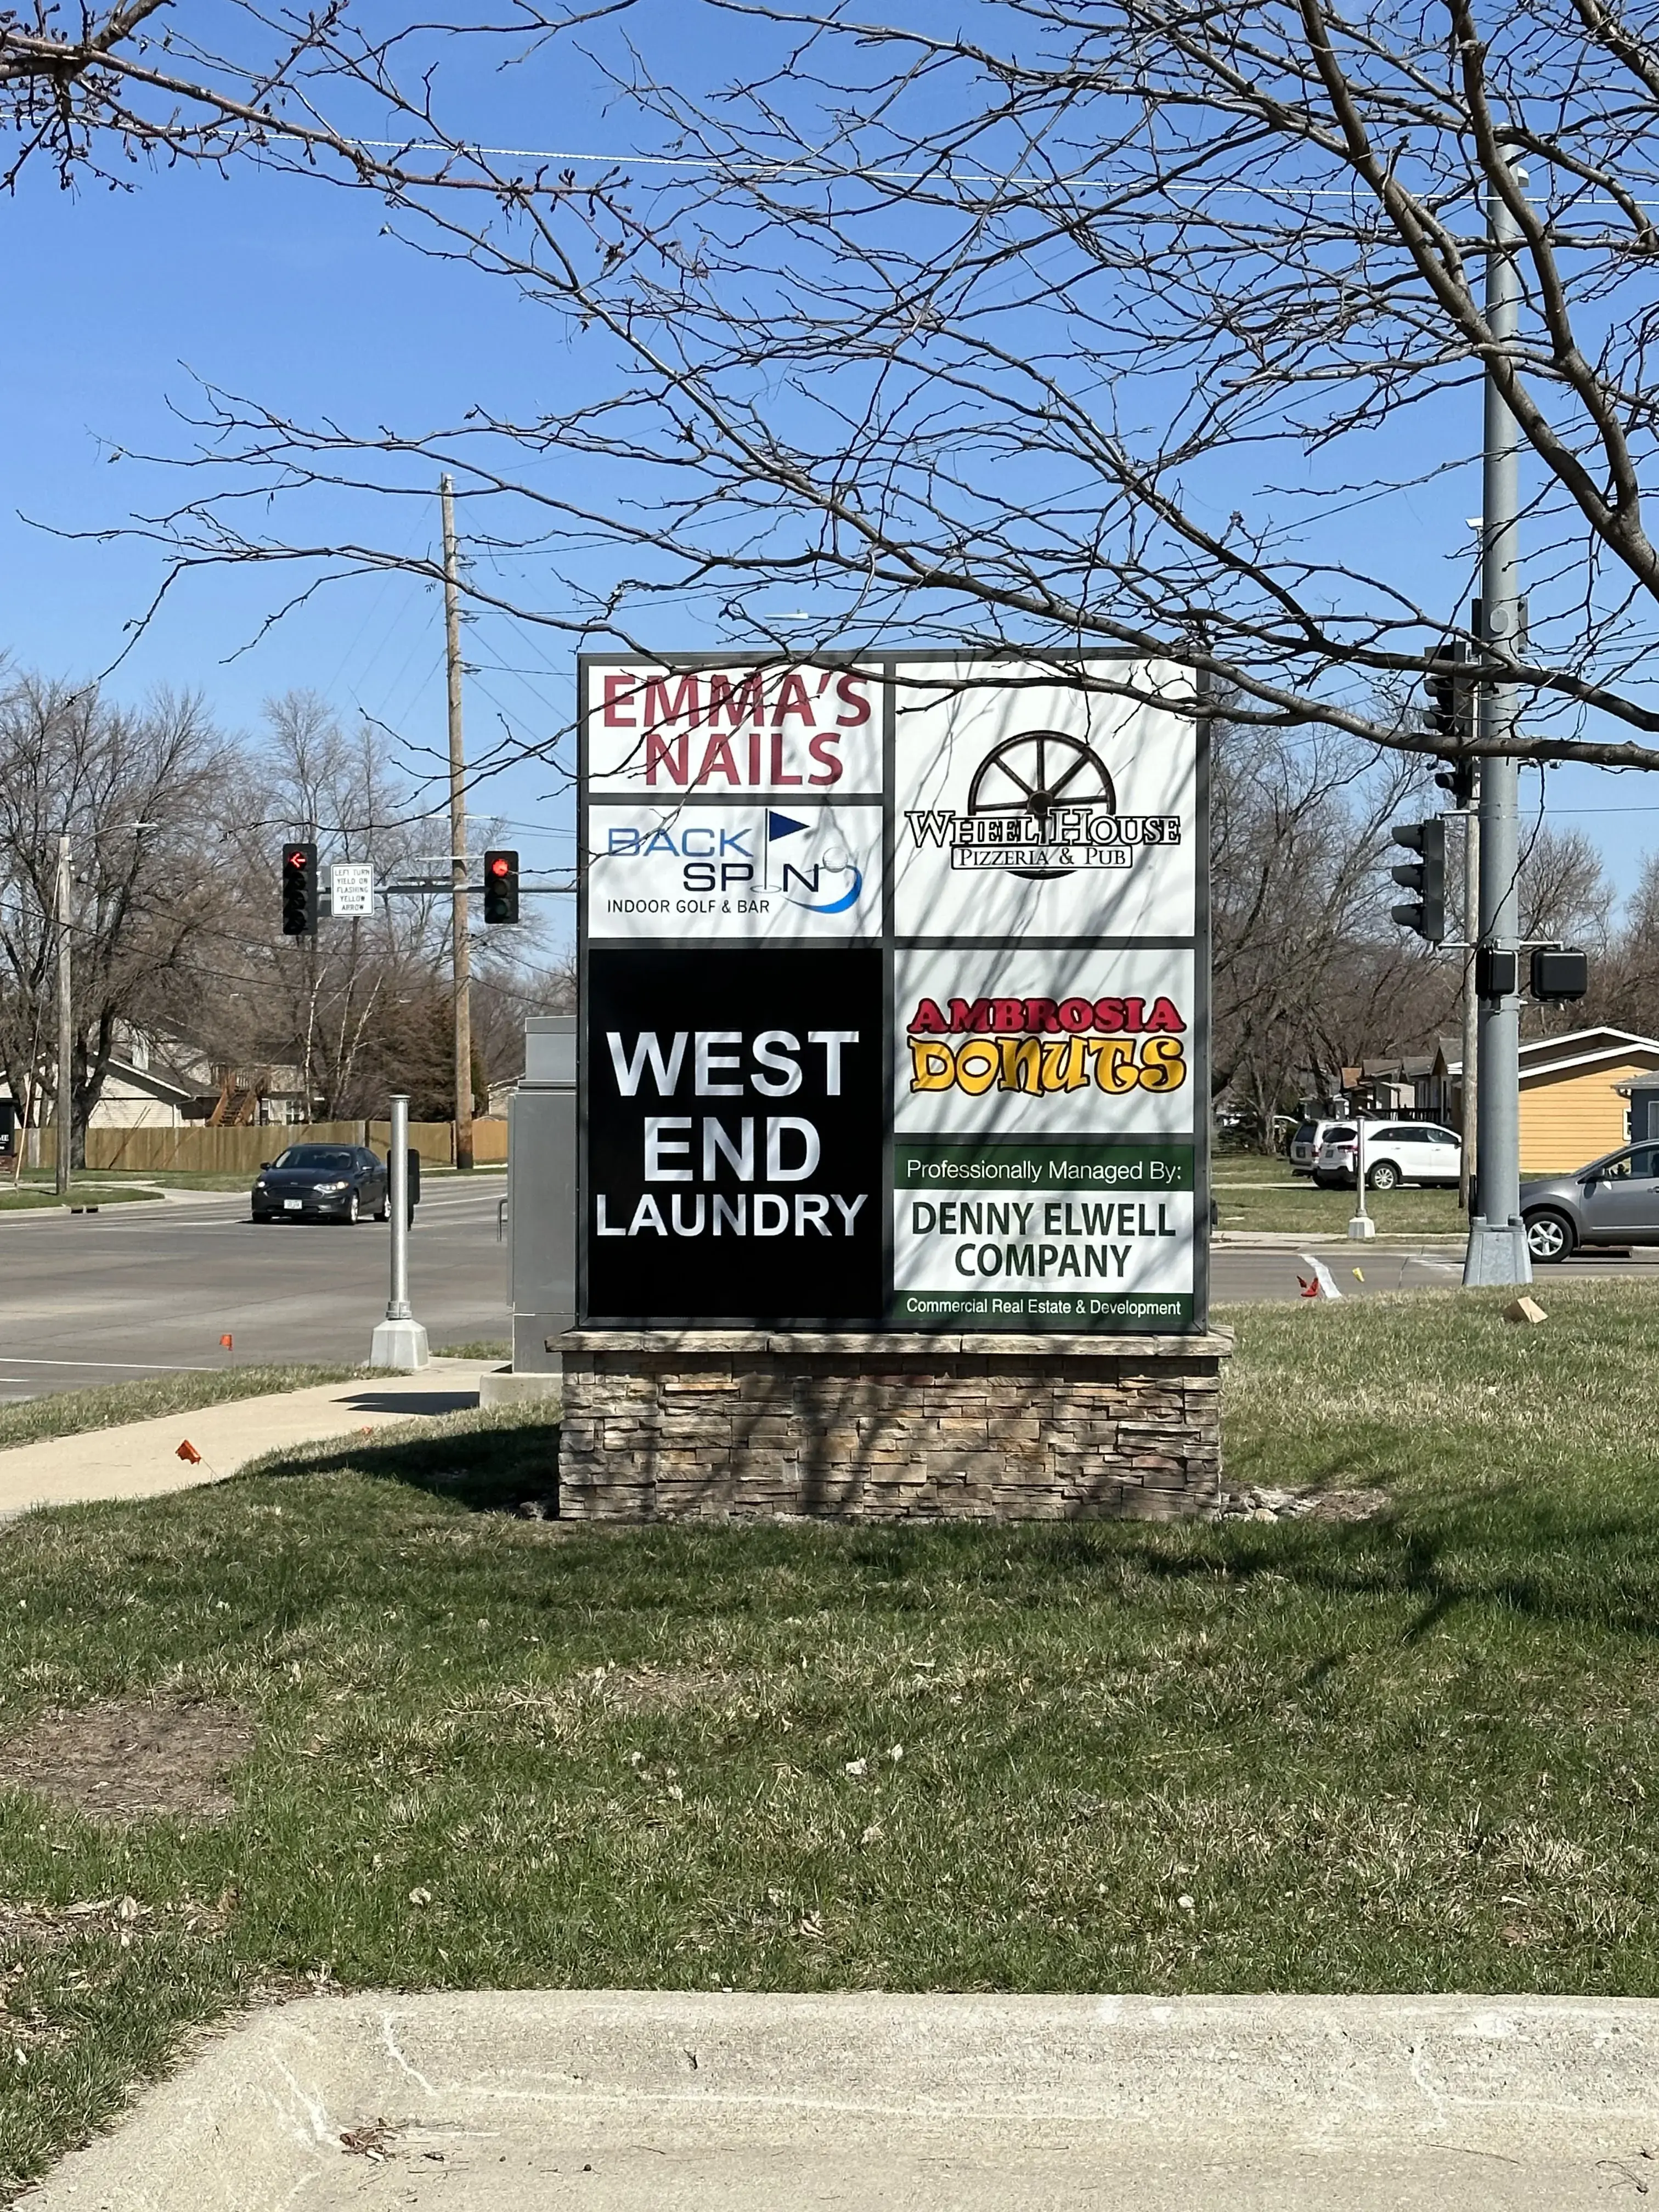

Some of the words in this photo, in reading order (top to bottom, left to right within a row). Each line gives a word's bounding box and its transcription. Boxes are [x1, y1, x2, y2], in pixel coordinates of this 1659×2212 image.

[604, 670, 871, 727] EMMA'S
[646, 732, 843, 786] NAILS
[607, 828, 754, 857] BACK
[1059, 848, 1074, 865] &
[607, 899, 670, 913] INDOOR
[676, 899, 716, 913] GOLF
[721, 900, 732, 913] &
[737, 900, 770, 913] BAR
[907, 996, 1187, 1035] AMBROSIA
[606, 1030, 860, 1097] WEST
[907, 1034, 1187, 1098] DONUTS
[644, 1116, 821, 1182] END
[907, 1159, 1043, 1183] Professionally
[1049, 1160, 1143, 1184] Managed
[1150, 1161, 1182, 1184] By:
[596, 1193, 868, 1237] LAUNDRY
[912, 1201, 1035, 1235] DENNY
[1044, 1203, 1176, 1237] ELWELL
[955, 1243, 1132, 1278] COMPANY
[906, 1297, 988, 1314] Commercial
[992, 1299, 1024, 1314] Real
[1028, 1299, 1071, 1314] Estate
[1076, 1300, 1086, 1314] &
[1090, 1299, 1182, 1319] Development
